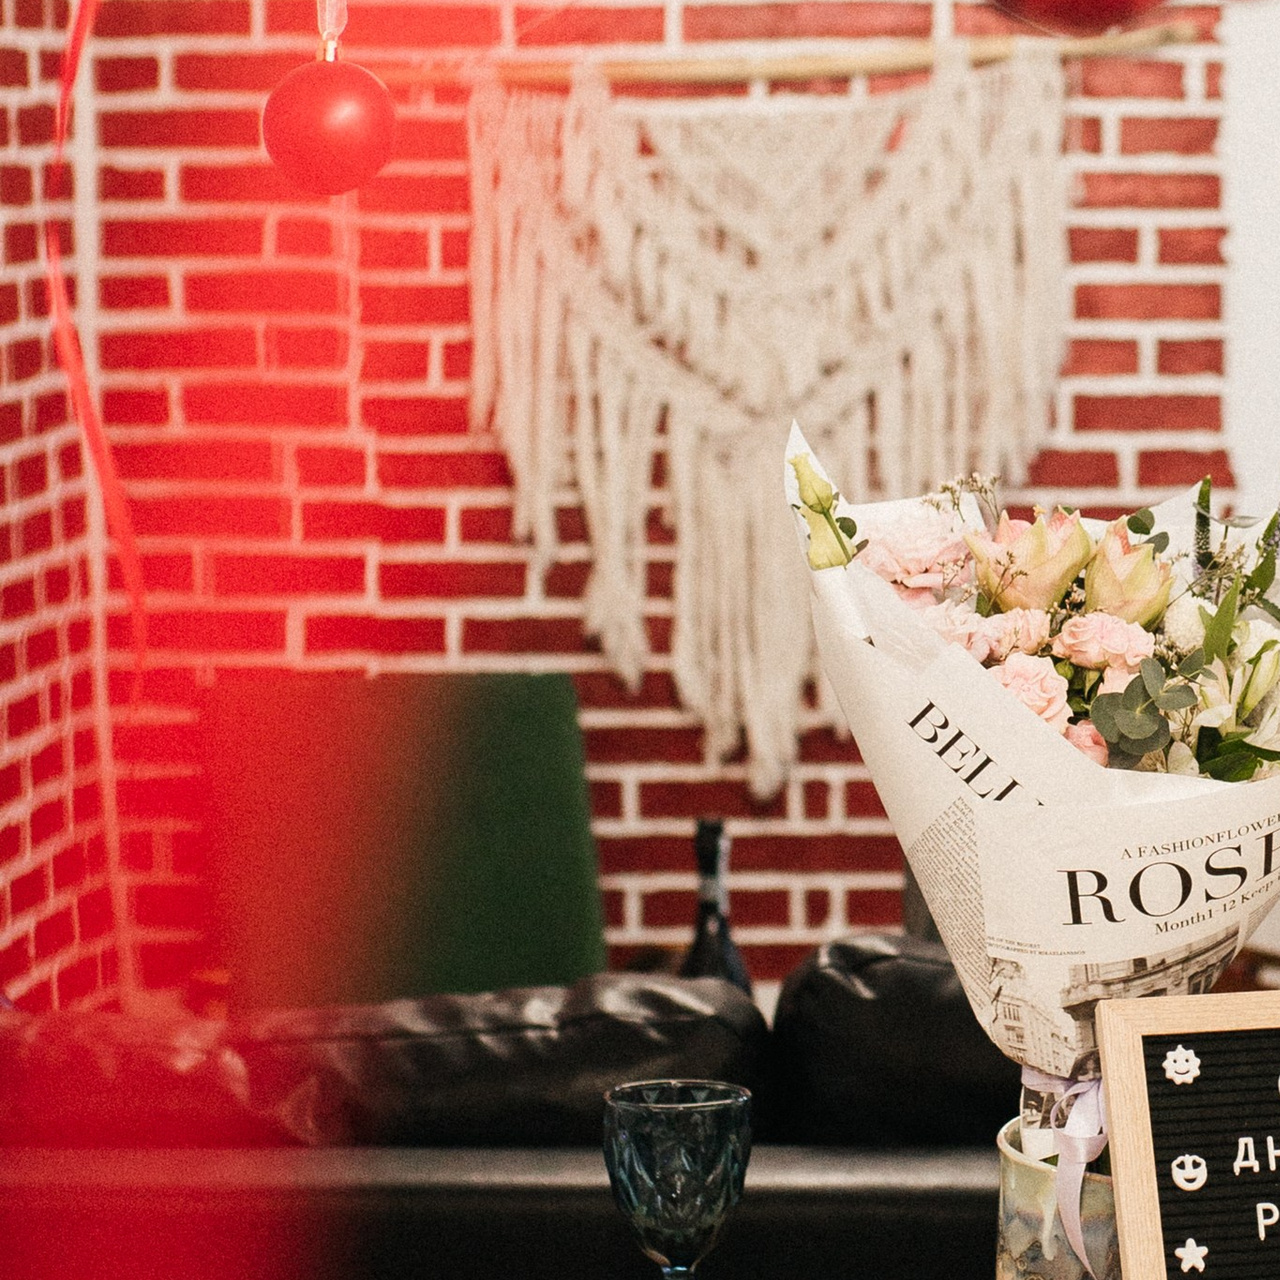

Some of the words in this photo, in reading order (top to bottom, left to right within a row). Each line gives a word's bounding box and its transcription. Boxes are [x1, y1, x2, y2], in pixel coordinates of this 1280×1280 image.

[904, 697, 1044, 807] BEL
[1120, 848, 1133, 860] A
[1240, 880, 1274, 904] Keep
